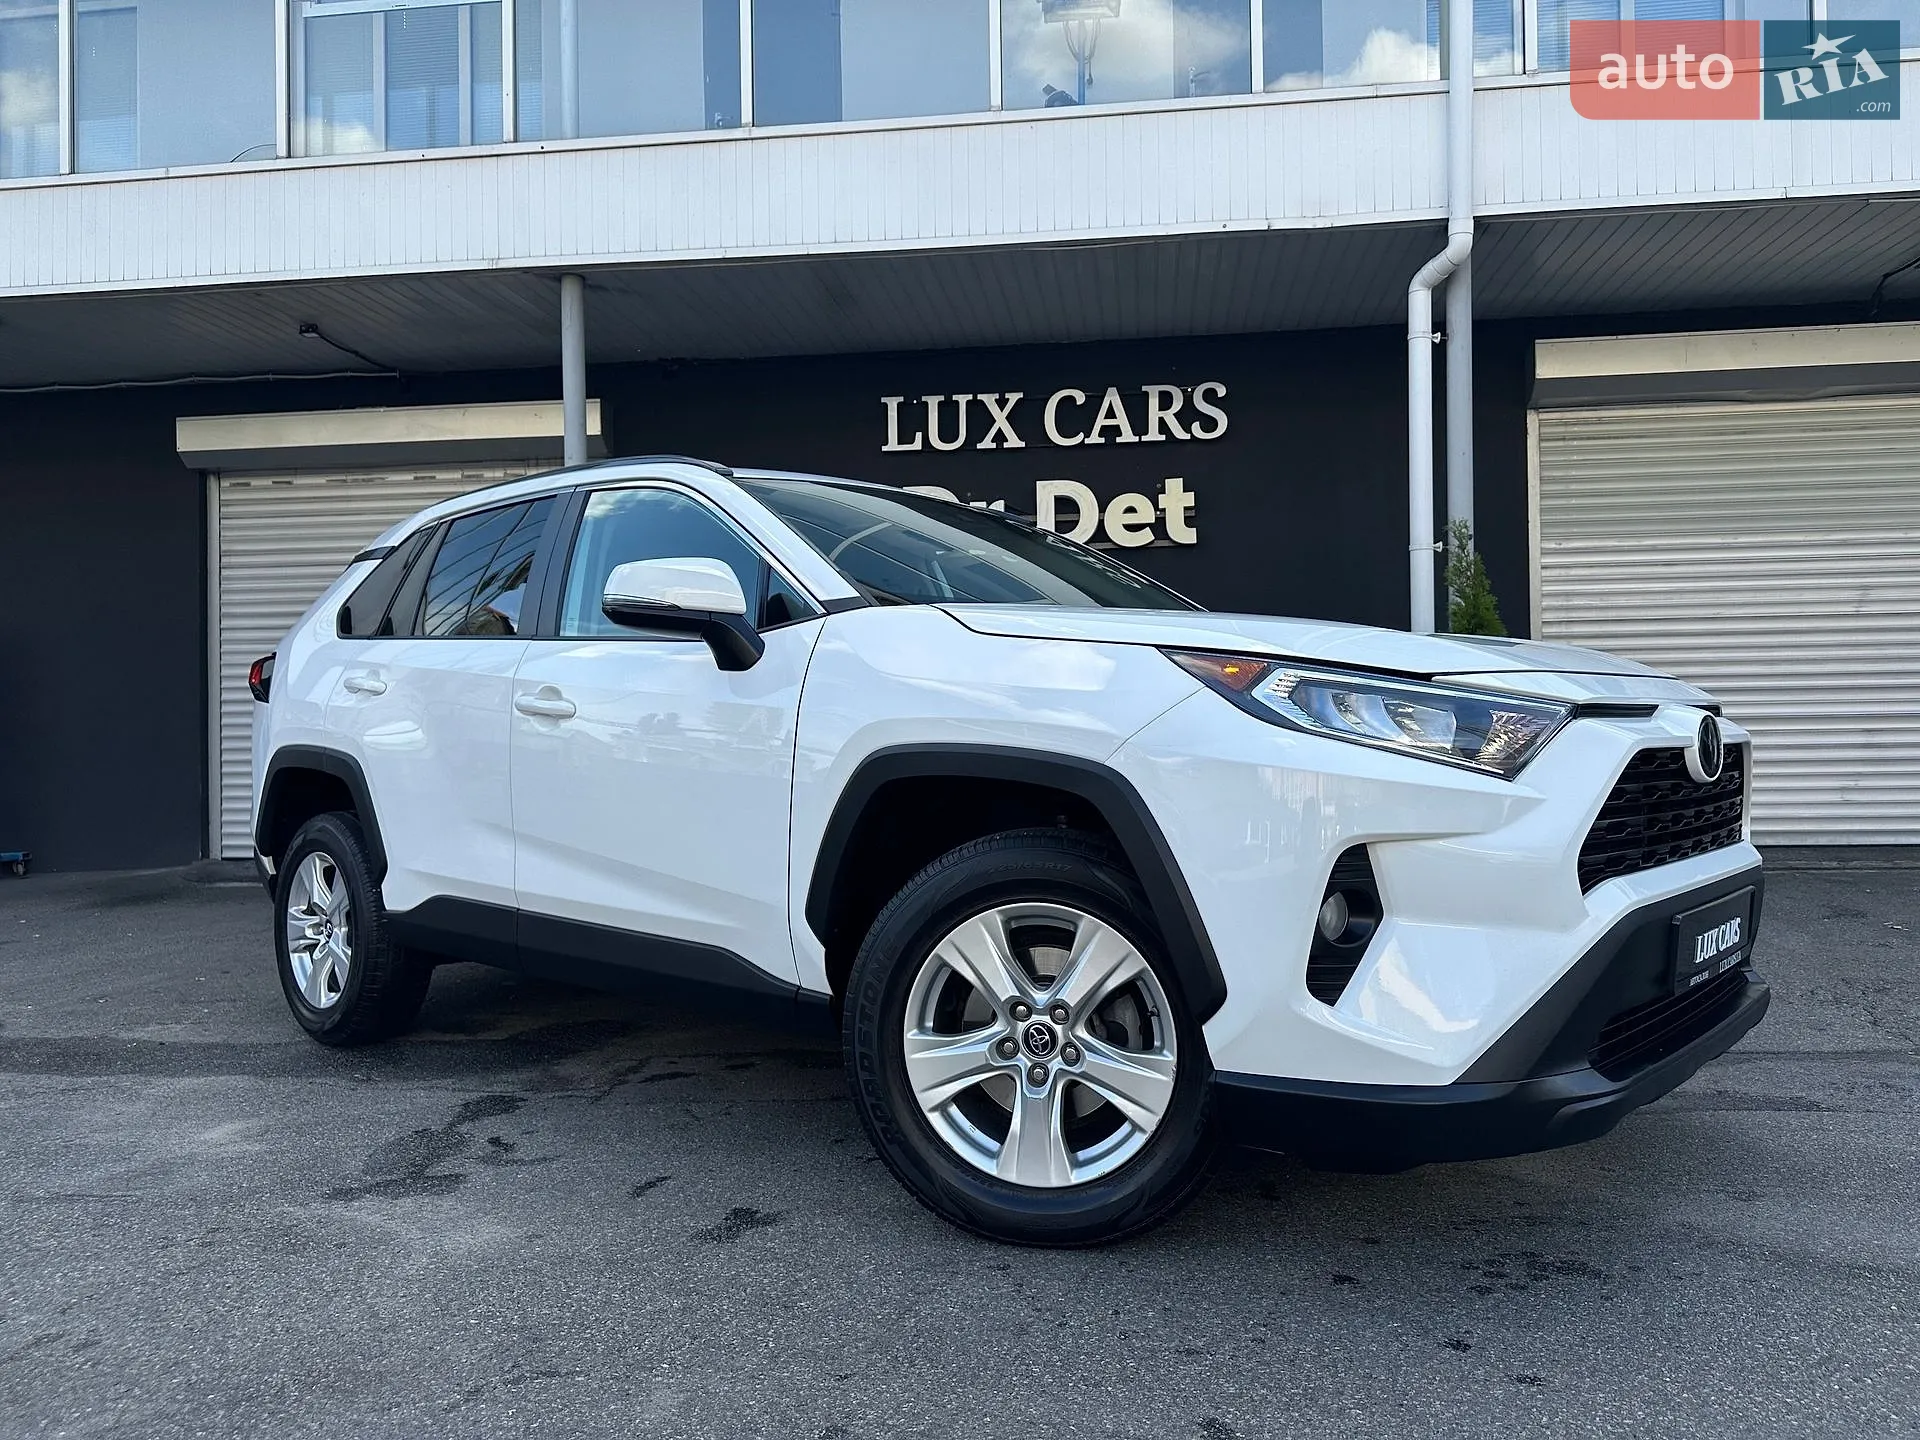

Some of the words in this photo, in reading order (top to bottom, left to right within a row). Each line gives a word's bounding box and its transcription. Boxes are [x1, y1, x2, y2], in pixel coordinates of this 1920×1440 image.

[881, 392, 1025, 452] LUX
[1044, 382, 1229, 447] CARS
[1036, 477, 1197, 548] Det
[1694, 928, 1719, 964] LUX
[1719, 917, 1742, 951] CARS
